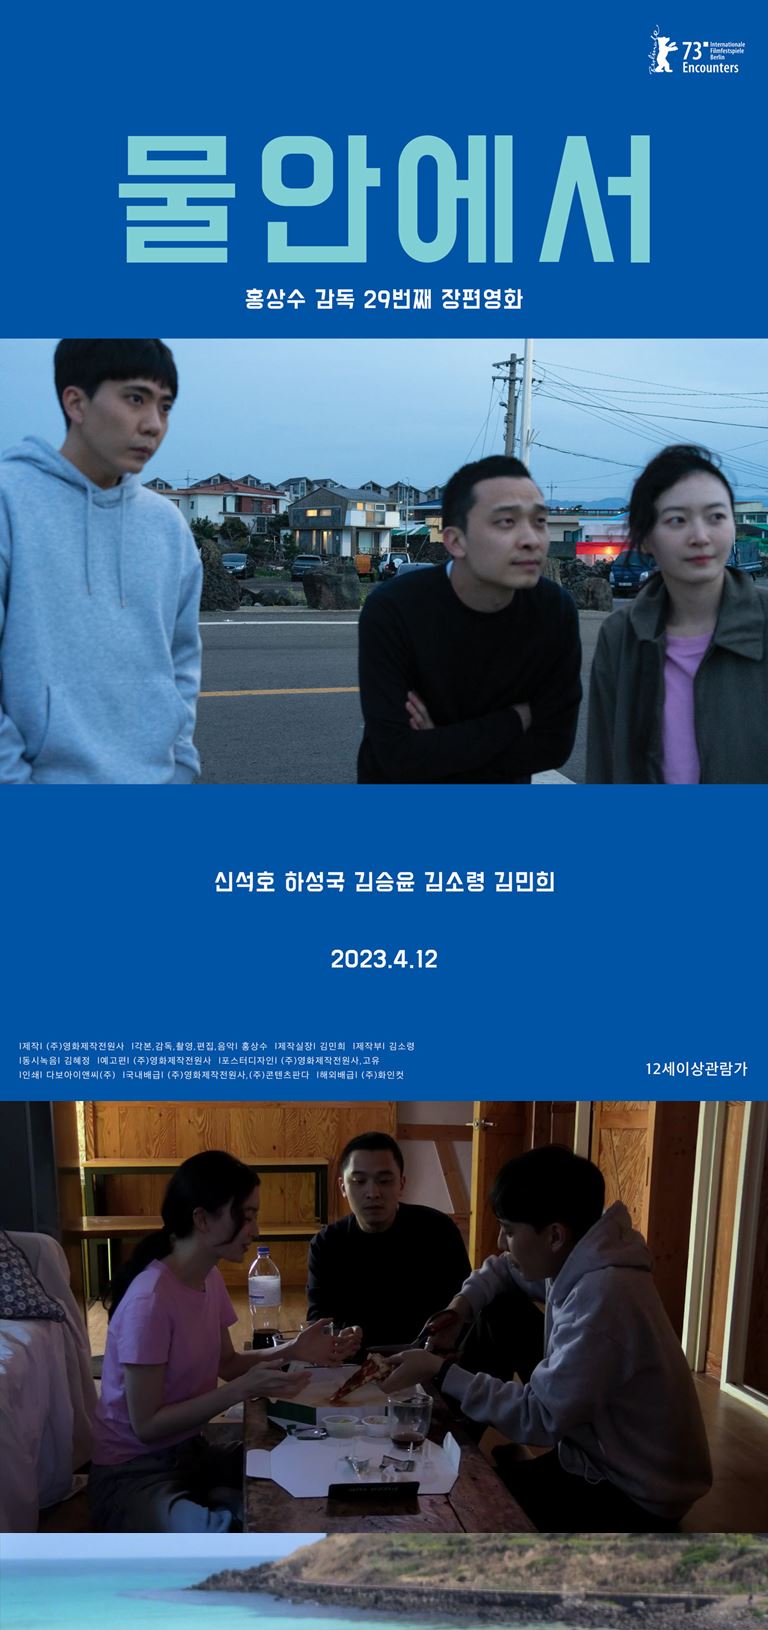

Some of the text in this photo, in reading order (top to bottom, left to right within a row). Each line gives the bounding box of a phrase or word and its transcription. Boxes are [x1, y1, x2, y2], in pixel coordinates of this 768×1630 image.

[710, 47, 745, 55] Filmfestspiele
[682, 61, 739, 74] Encounters
[118, 134, 651, 264] 물안에서
[245, 287, 524, 310] 홍상수 감독 29번째 장편영화
[214, 870, 555, 893] 신석호 하성국 김승윤 김소령 김민희
[330, 948, 438, 969] 2023.4.12
[46, 1041, 124, 1052] (주)영화제작전원사
[241, 1041, 268, 1052] 홍상수
[319, 1041, 346, 1052] 김민희
[389, 1041, 415, 1052] 김소령
[64, 1055, 90, 1066] 김혜정
[133, 1055, 211, 1066] (주)영화제작전원사
[46, 1070, 116, 1081] 다보아이앤씨(주)
[645, 1061, 748, 1077] 12세이상관람가
